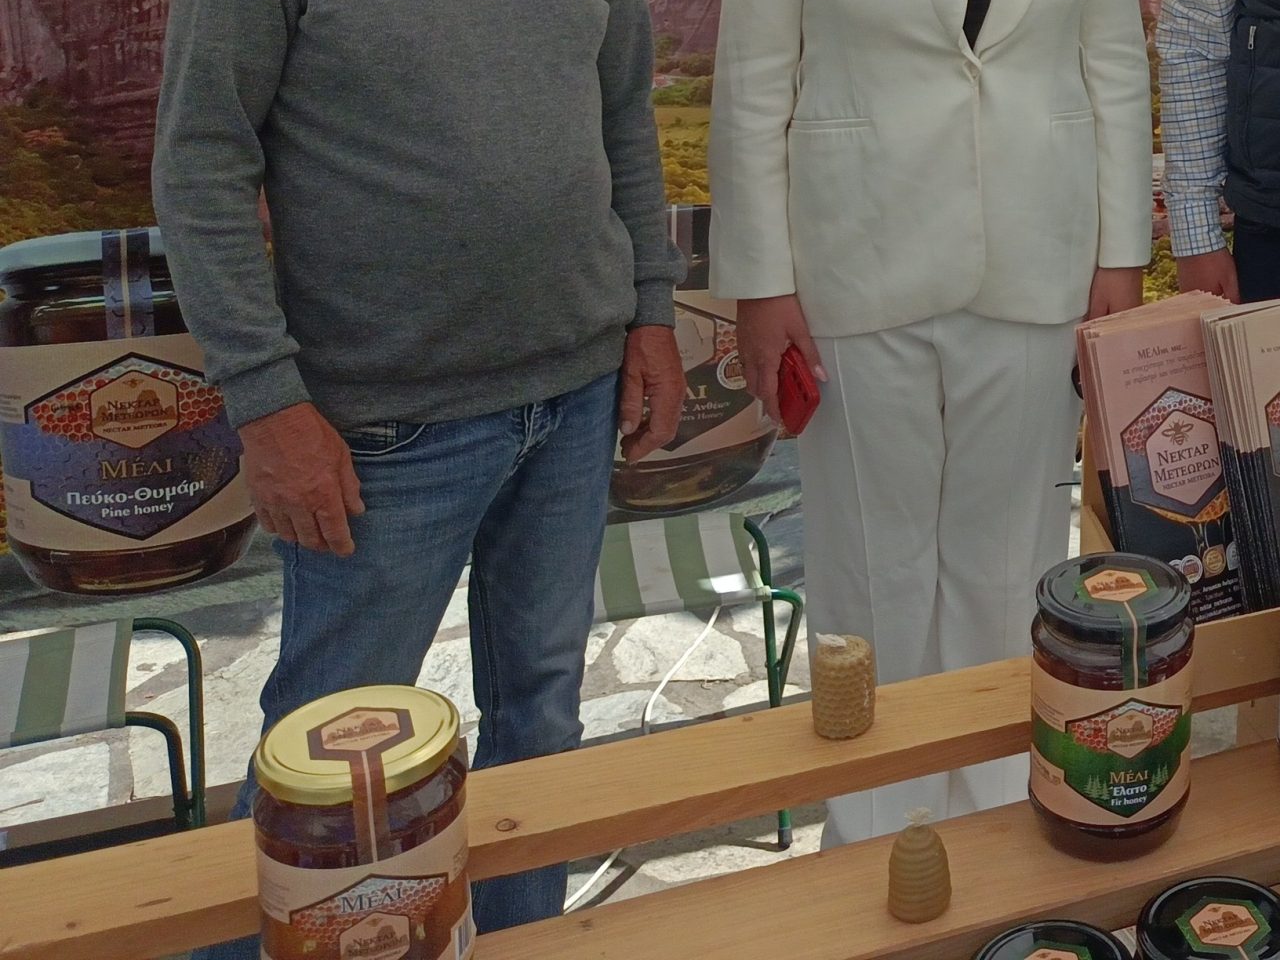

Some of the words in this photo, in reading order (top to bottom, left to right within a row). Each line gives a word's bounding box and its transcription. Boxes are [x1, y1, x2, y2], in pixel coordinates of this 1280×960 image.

[66, 479, 205, 506] Πεύκο-Θυμάρι
[101, 506, 131, 518] Pine
[134, 501, 175, 516] honey
[1110, 797, 1122, 807] Fir
[1123, 794, 1148, 807] honey
